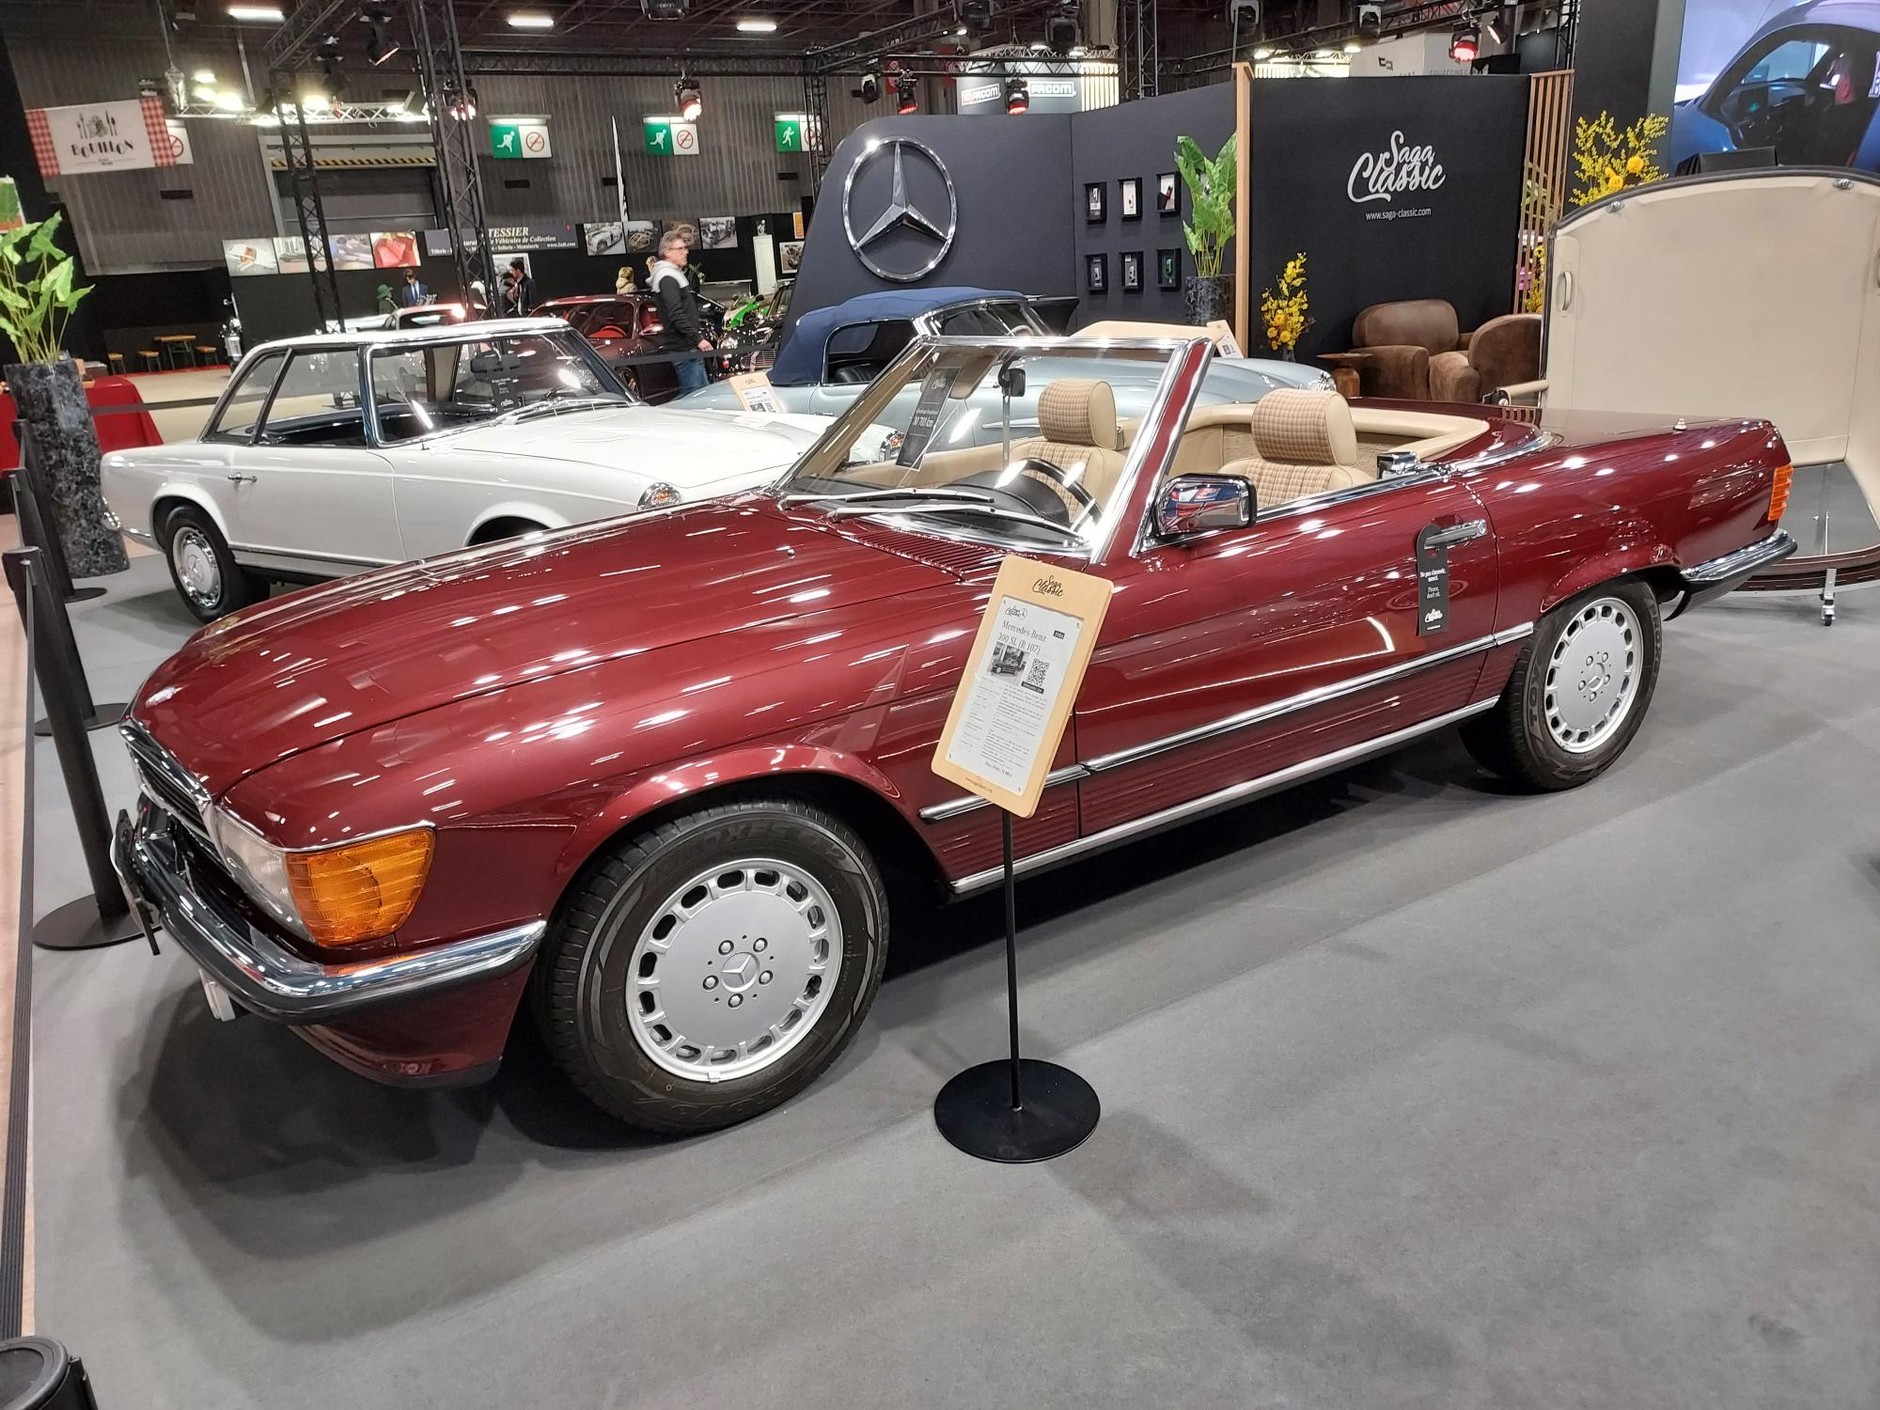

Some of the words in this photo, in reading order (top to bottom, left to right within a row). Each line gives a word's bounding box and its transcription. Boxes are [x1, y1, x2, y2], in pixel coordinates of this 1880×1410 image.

[70, 139, 134, 158] BOUILLON
[1382, 130, 1436, 171] Saga
[1347, 152, 1446, 203] Classic
[1365, 207, 1432, 221] www.saga-classic.com
[487, 226, 529, 238] TESSIER
[1032, 579, 1064, 597] Classic
